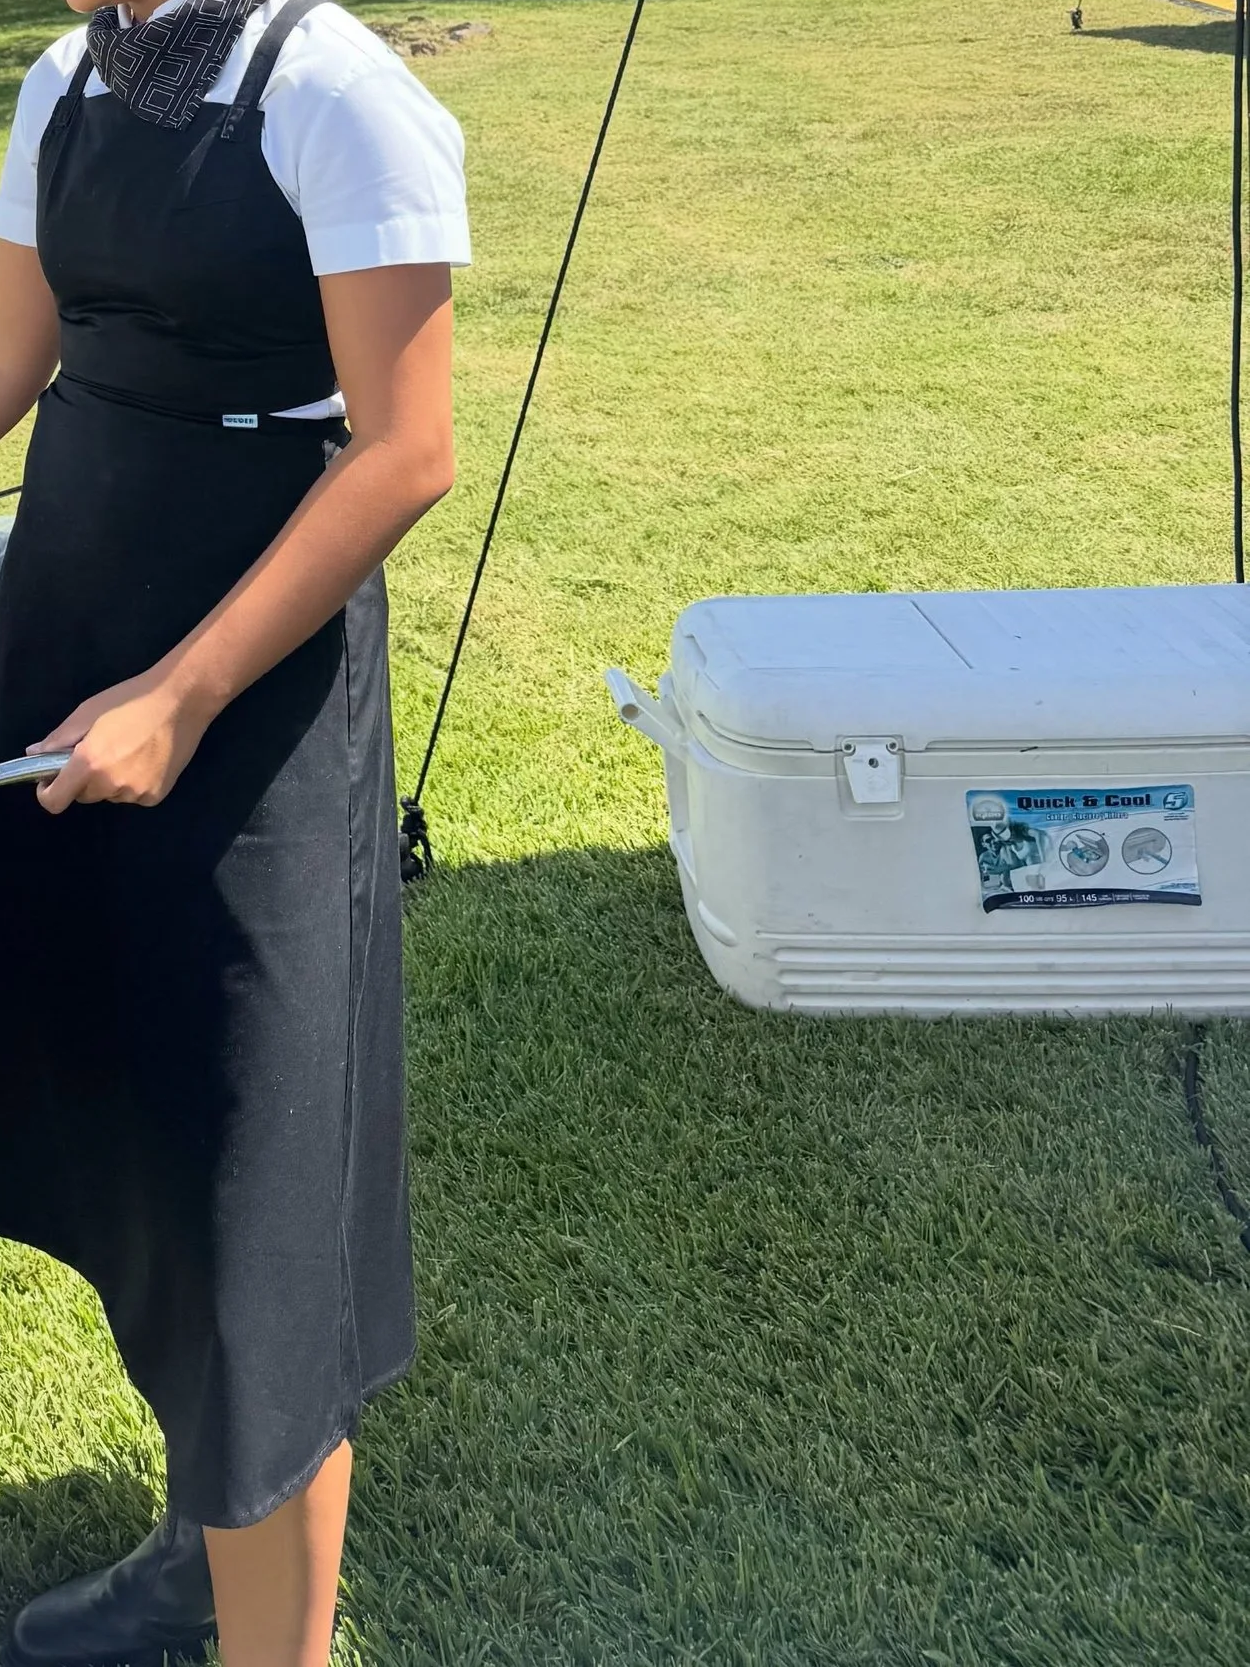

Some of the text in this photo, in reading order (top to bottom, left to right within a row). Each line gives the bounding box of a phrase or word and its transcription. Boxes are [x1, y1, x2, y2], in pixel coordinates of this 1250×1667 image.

[1017, 794, 1151, 810] Quick & Cool
[1019, 895, 1035, 903] 100
[1056, 894, 1067, 903] 95
[1081, 893, 1097, 902] 145
